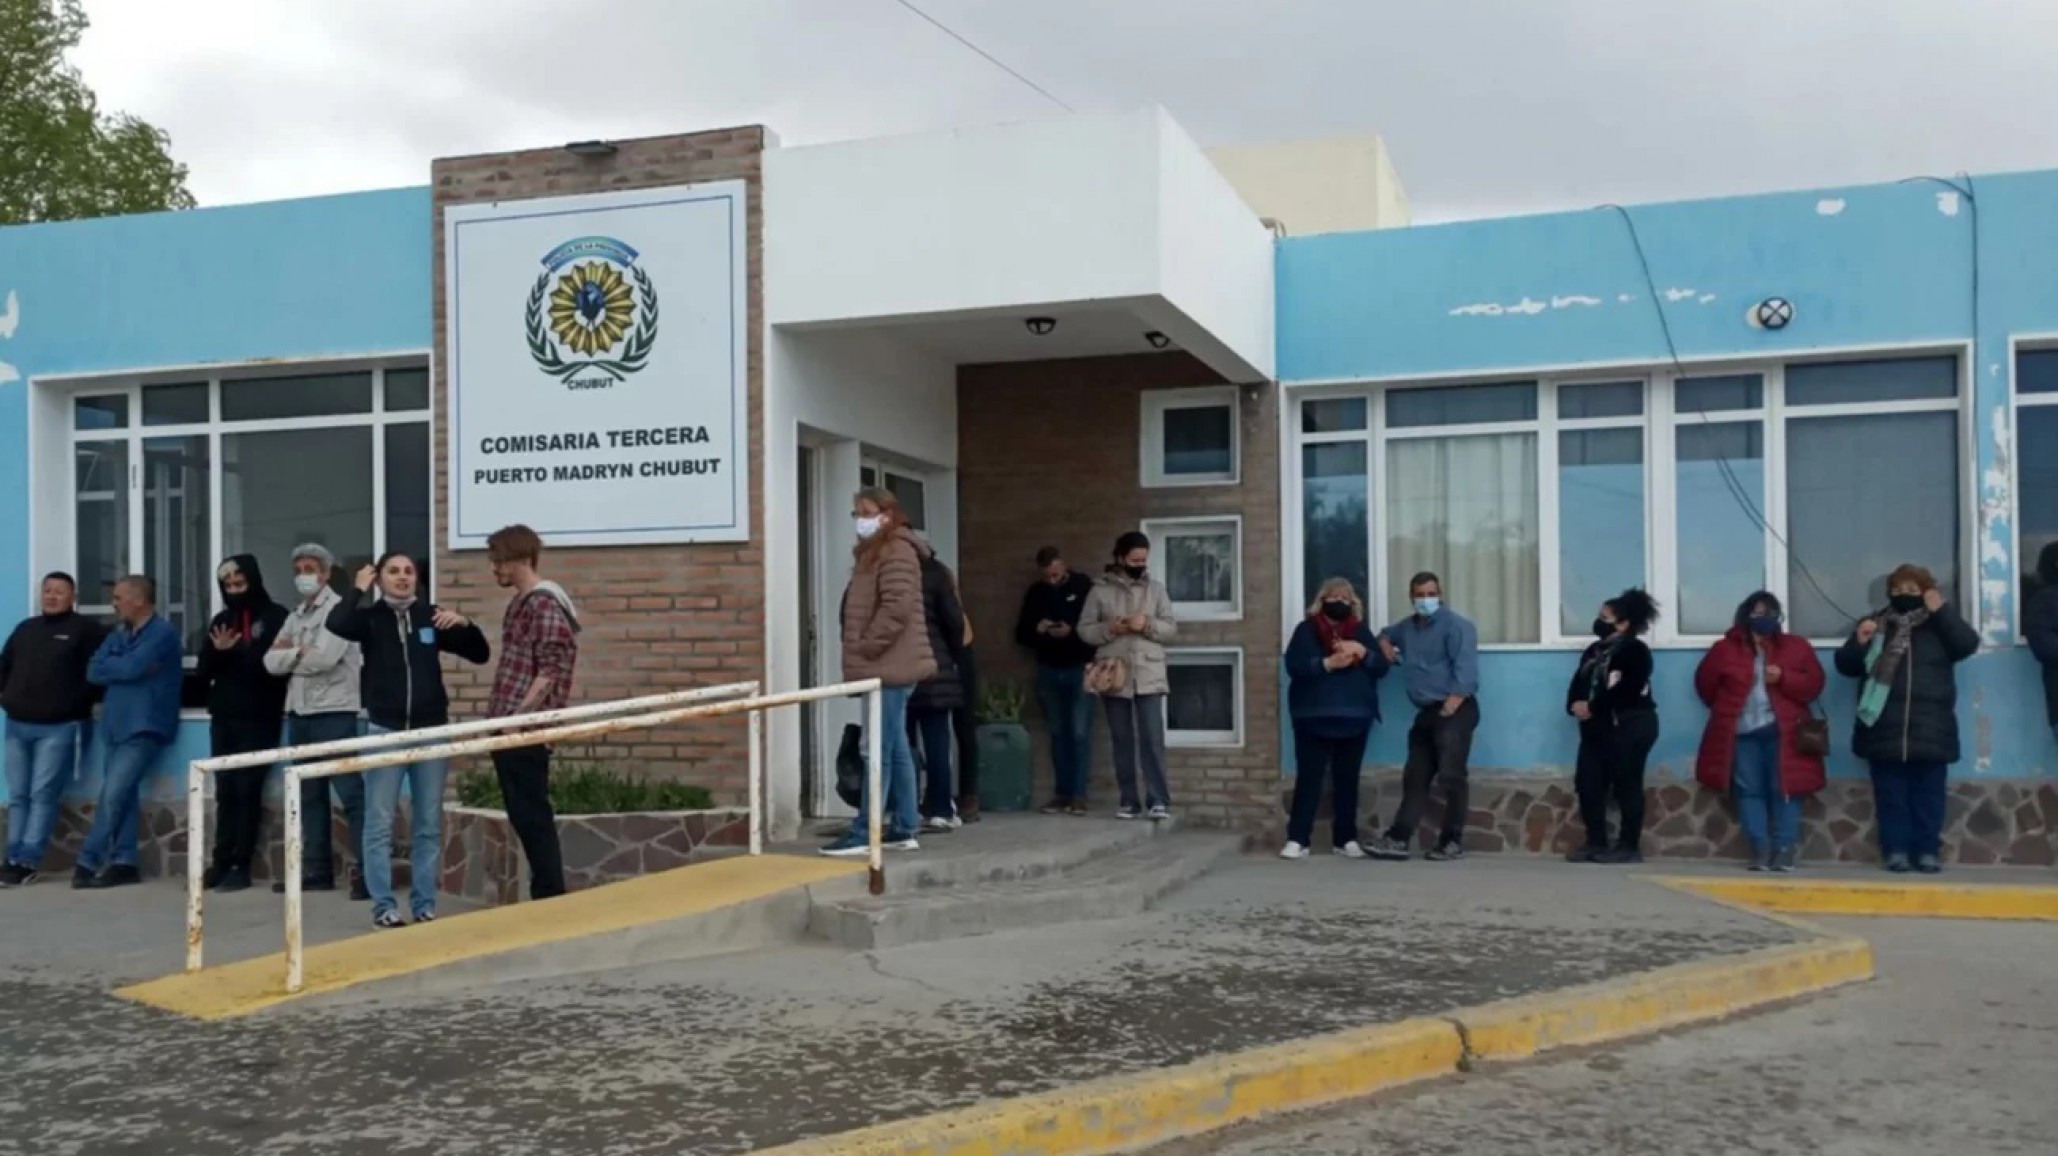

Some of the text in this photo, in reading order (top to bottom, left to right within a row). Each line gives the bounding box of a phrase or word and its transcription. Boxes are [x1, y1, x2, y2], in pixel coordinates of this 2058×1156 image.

[567, 377, 613, 390] CHUBUT
[480, 426, 710, 454] COMISARIA TERCERA
[474, 458, 720, 484] PUERTO MADRYN CHUBUT
